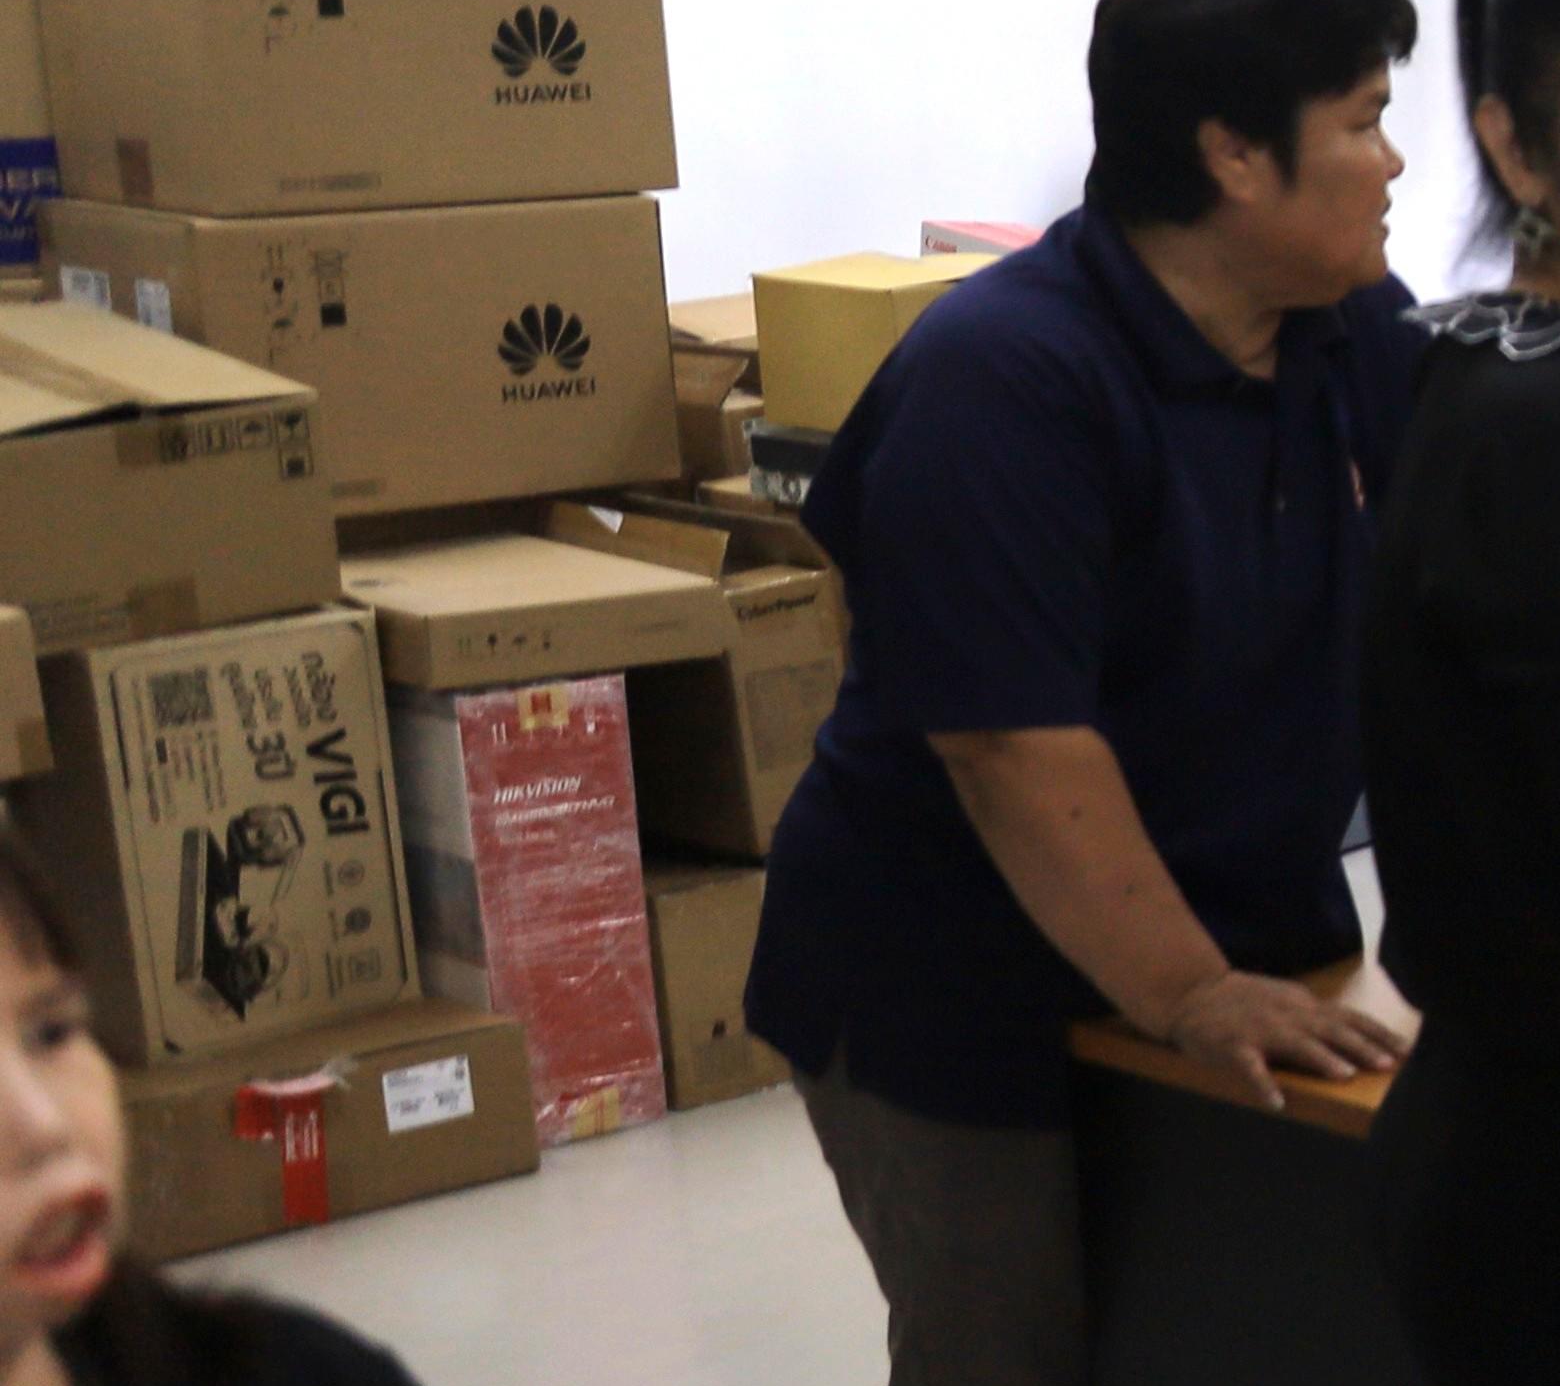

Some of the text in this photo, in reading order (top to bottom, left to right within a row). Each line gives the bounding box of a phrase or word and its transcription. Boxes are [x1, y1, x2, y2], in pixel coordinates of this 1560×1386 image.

[496, 81, 592, 105] HUAWEI
[501, 376, 597, 405] HUAWEI
[737, 591, 818, 622] CyberPower
[305, 727, 371, 837] VIGI
[493, 774, 583, 805] HIKVISION
